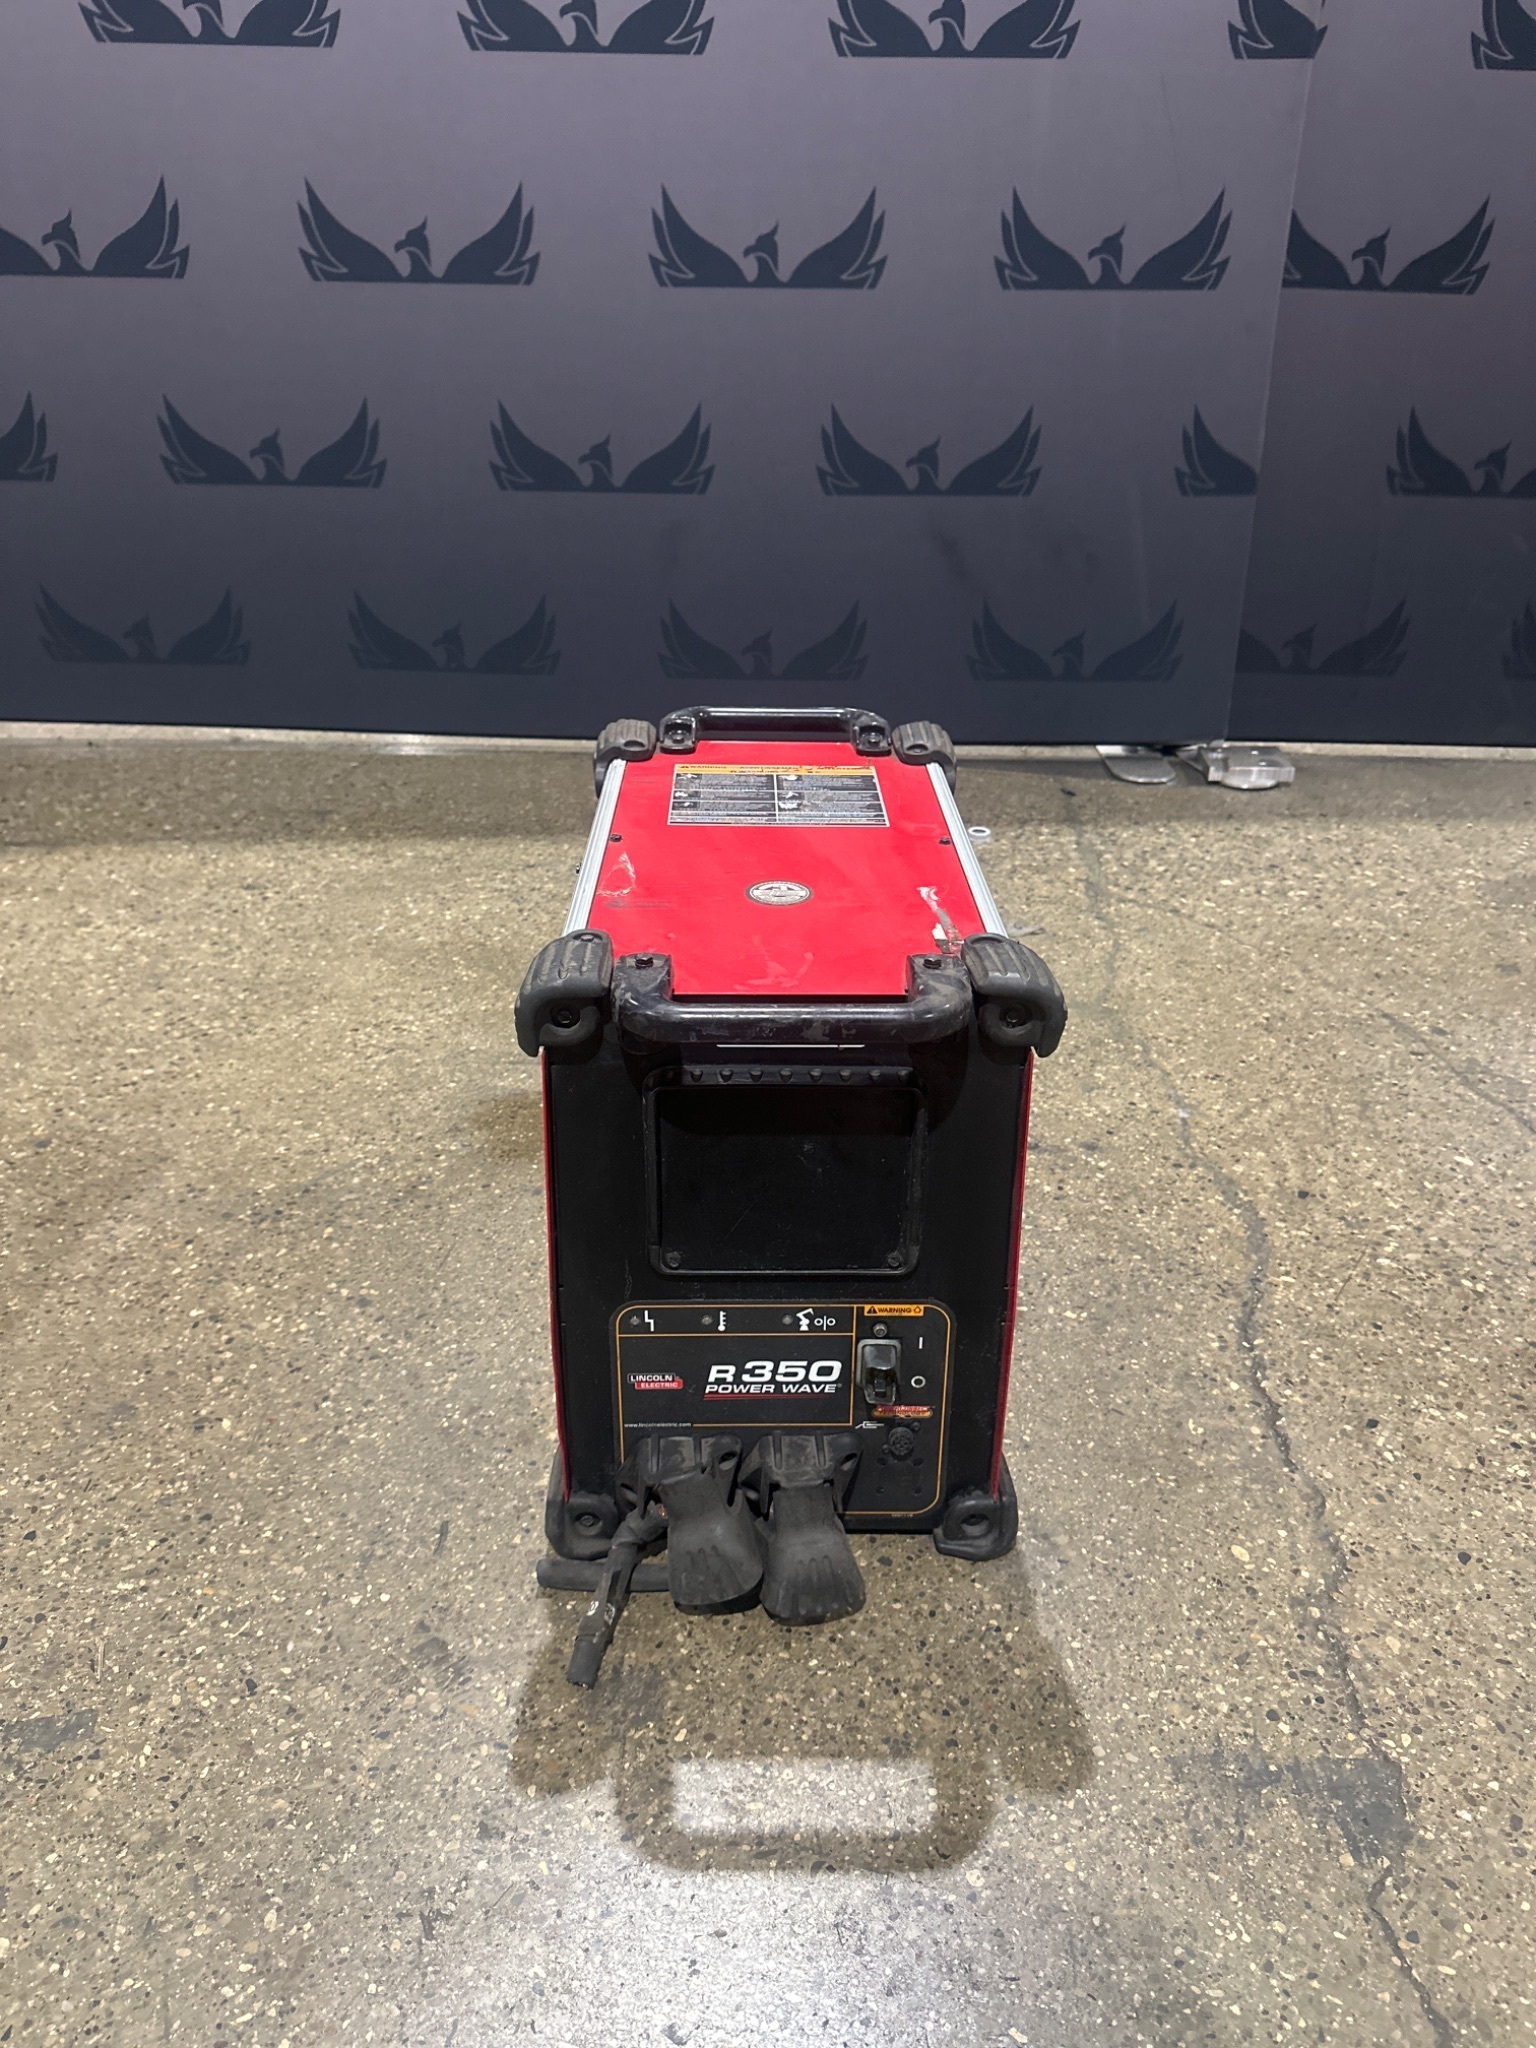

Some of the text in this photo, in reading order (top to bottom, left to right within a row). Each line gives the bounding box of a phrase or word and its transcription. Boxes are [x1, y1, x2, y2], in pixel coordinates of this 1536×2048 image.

[707, 1360, 842, 1383] R 350
[630, 1374, 673, 1382] LINCOLN
[705, 1384, 837, 1394] POWER WAVE
